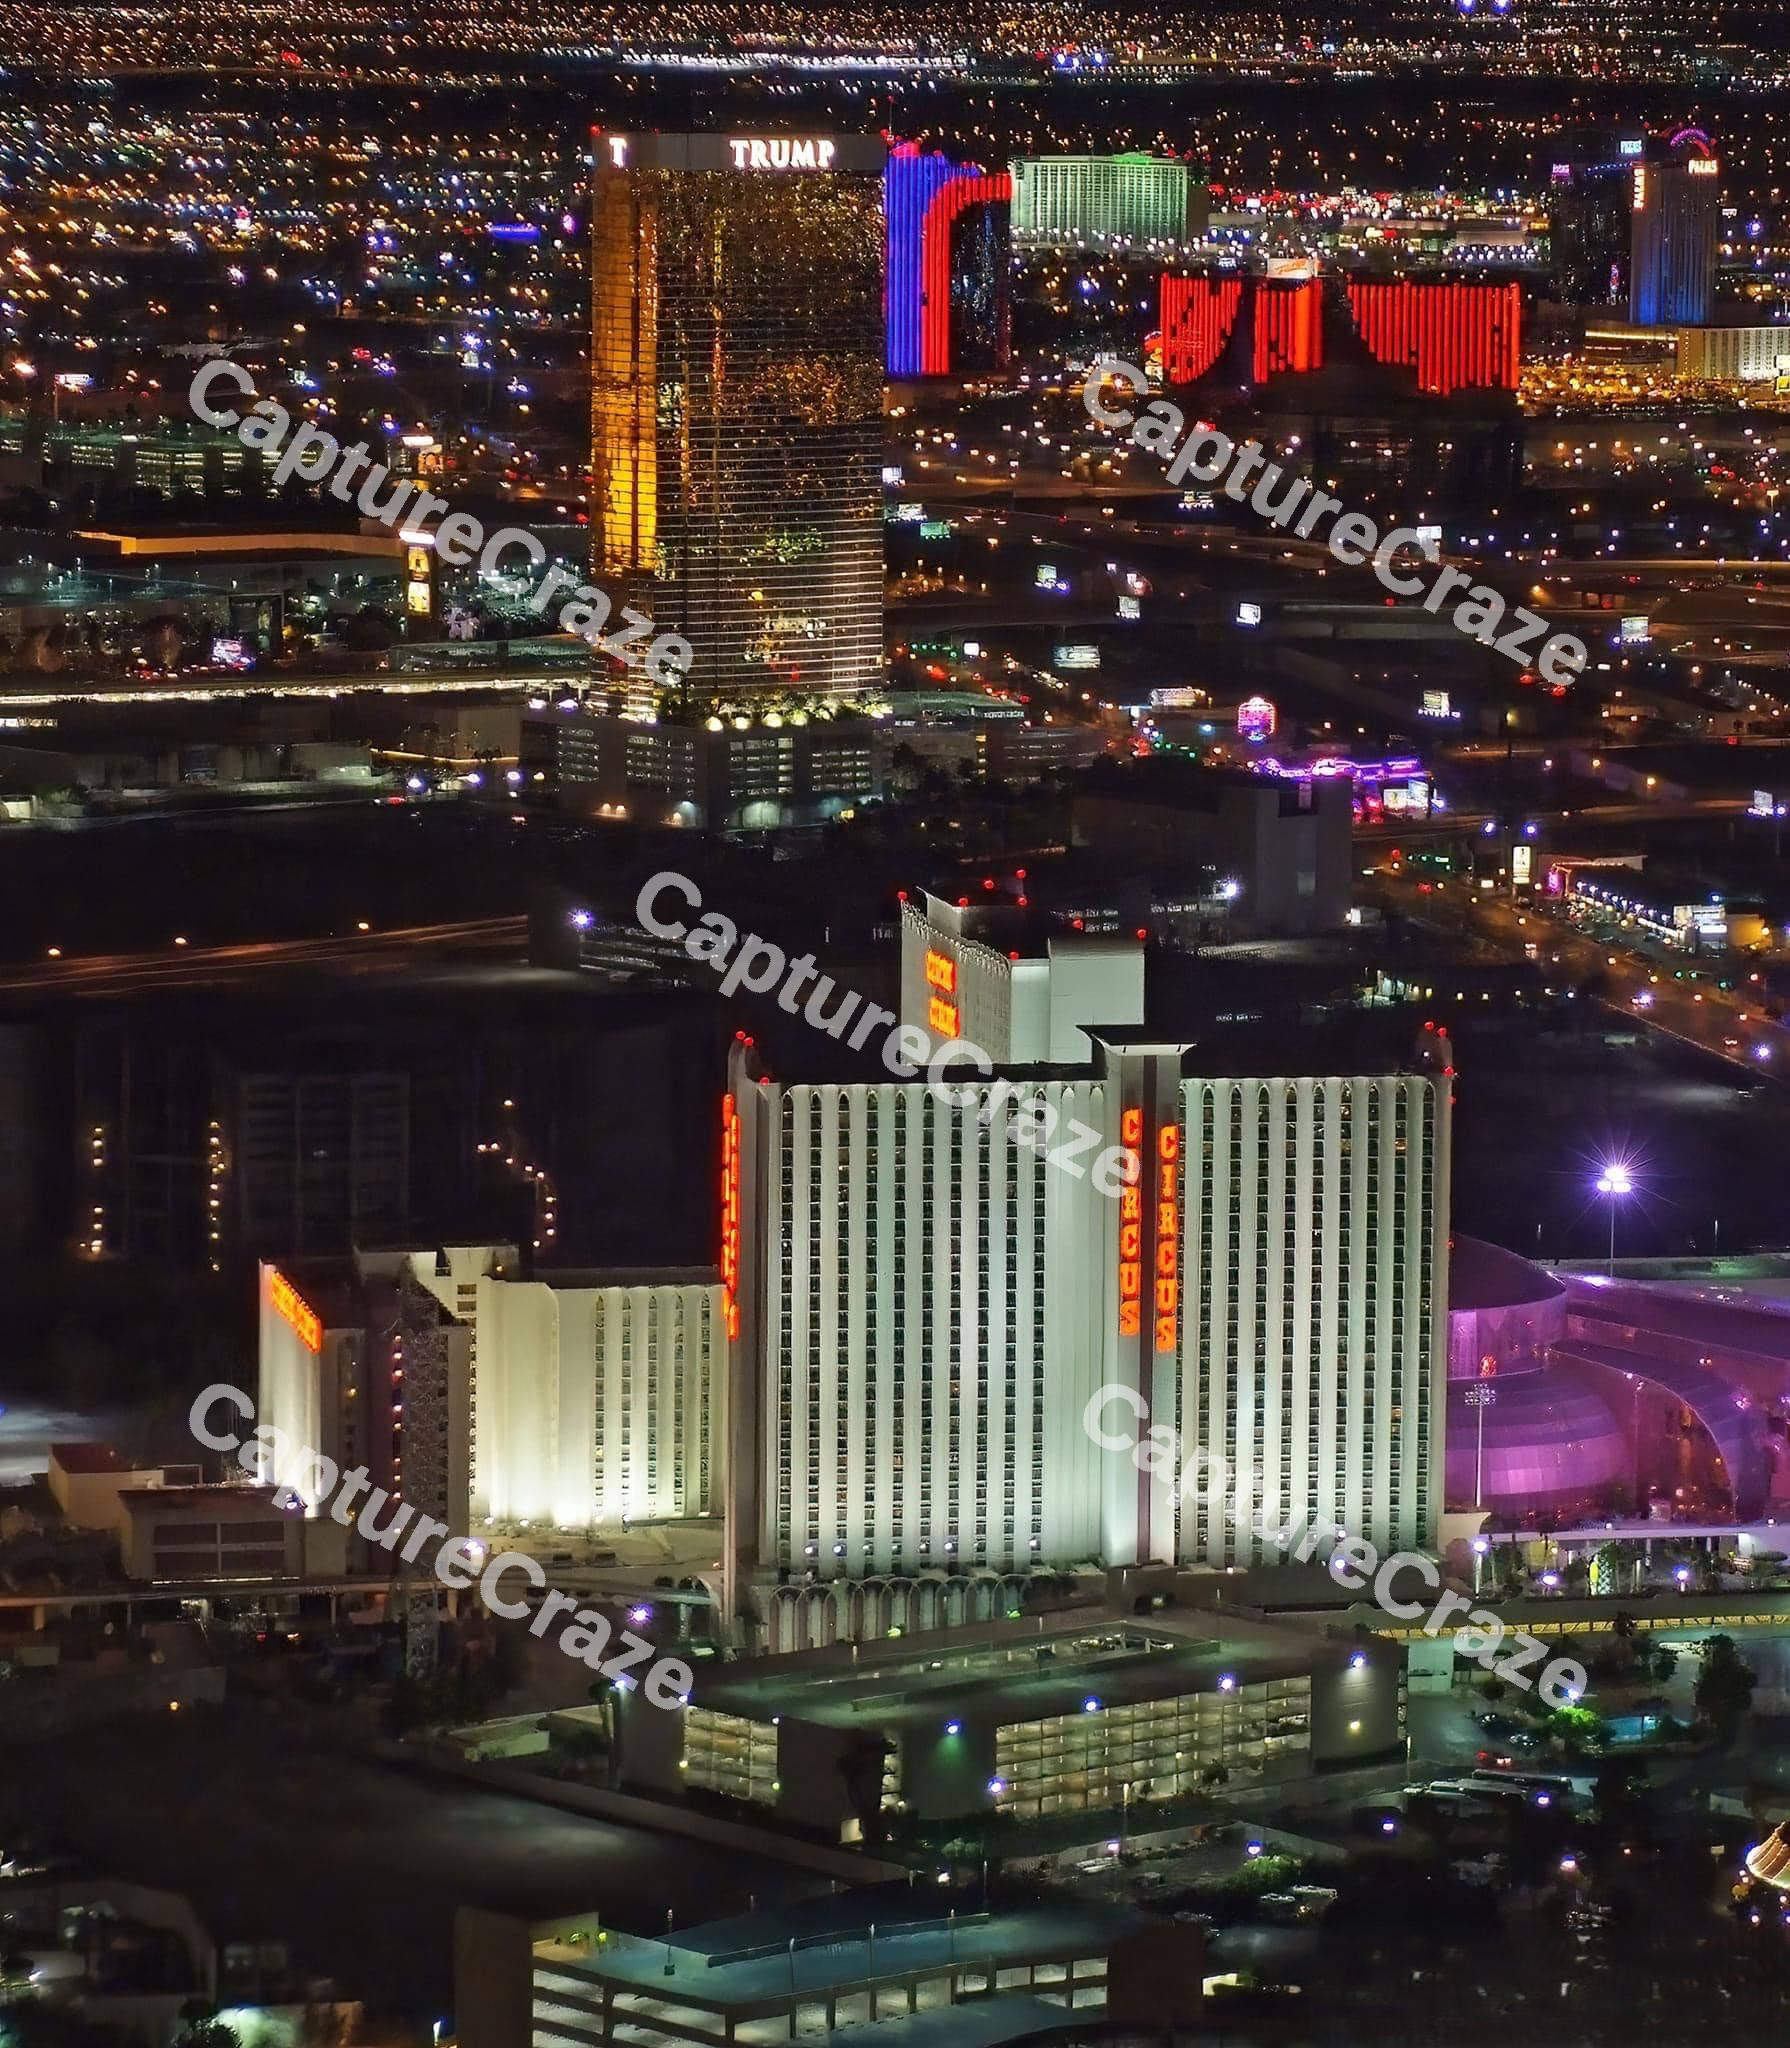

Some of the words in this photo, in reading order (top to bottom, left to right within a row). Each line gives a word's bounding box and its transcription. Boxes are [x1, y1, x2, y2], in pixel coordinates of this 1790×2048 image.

[729, 139, 835, 168] TRUMP
[1119, 1108, 1143, 1336] CIRCUS
[1155, 1125, 1179, 1353] CIRCUS
